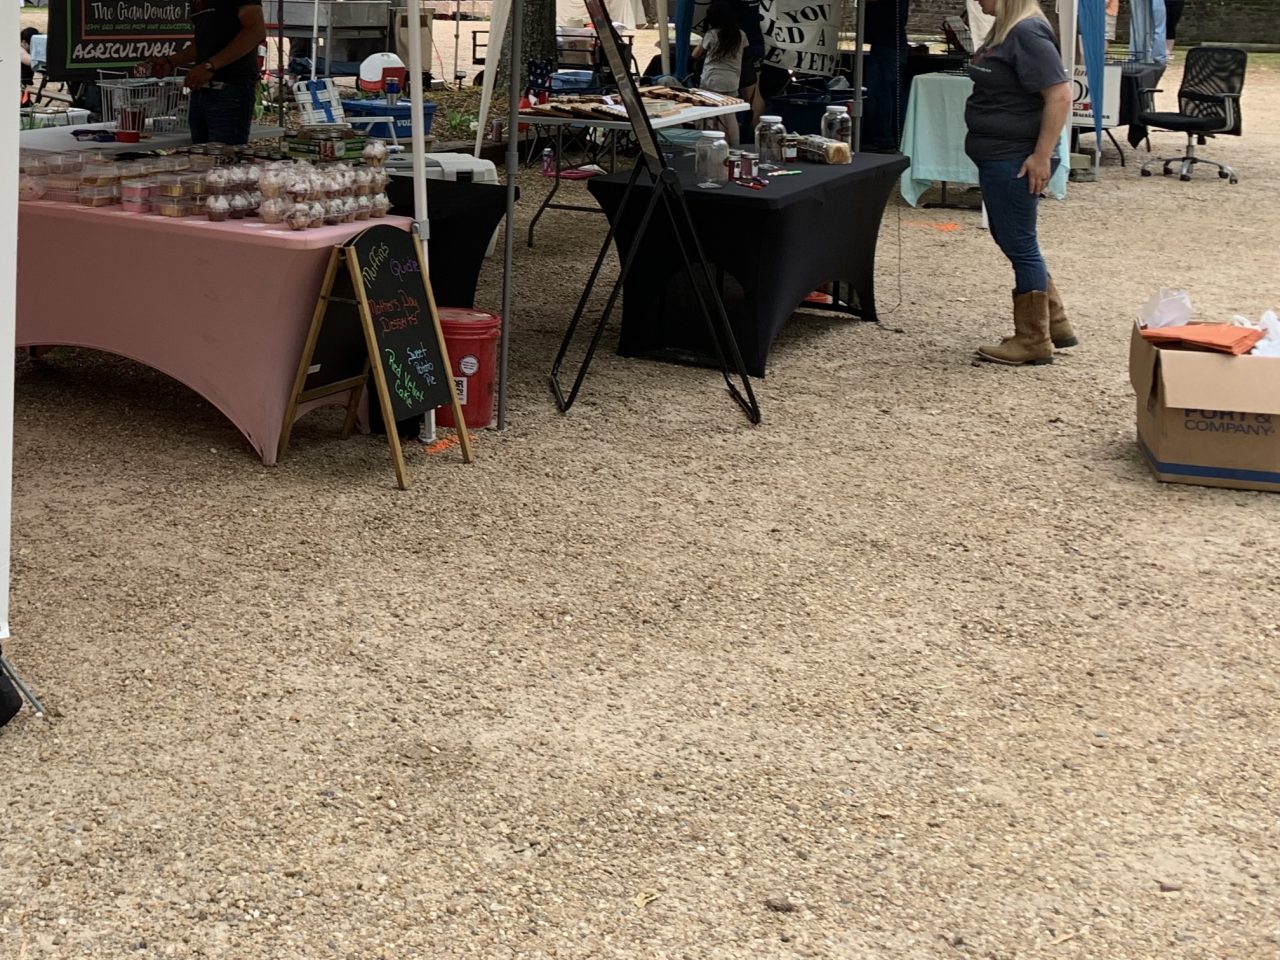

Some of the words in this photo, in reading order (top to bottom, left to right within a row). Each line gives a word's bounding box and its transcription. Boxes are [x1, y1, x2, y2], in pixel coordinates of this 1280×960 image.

[91, 2, 113, 20] The
[117, 1, 182, 21] GianDonato
[781, 4, 831, 24] YOU
[763, 18, 805, 43] IED
[816, 28, 825, 46] A
[73, 41, 177, 59] AGRICULTURAL
[793, 51, 835, 72] YET?
[363, 242, 389, 288] Muffins
[385, 349, 402, 379] Red
[1184, 420, 1272, 436] COMPANY
